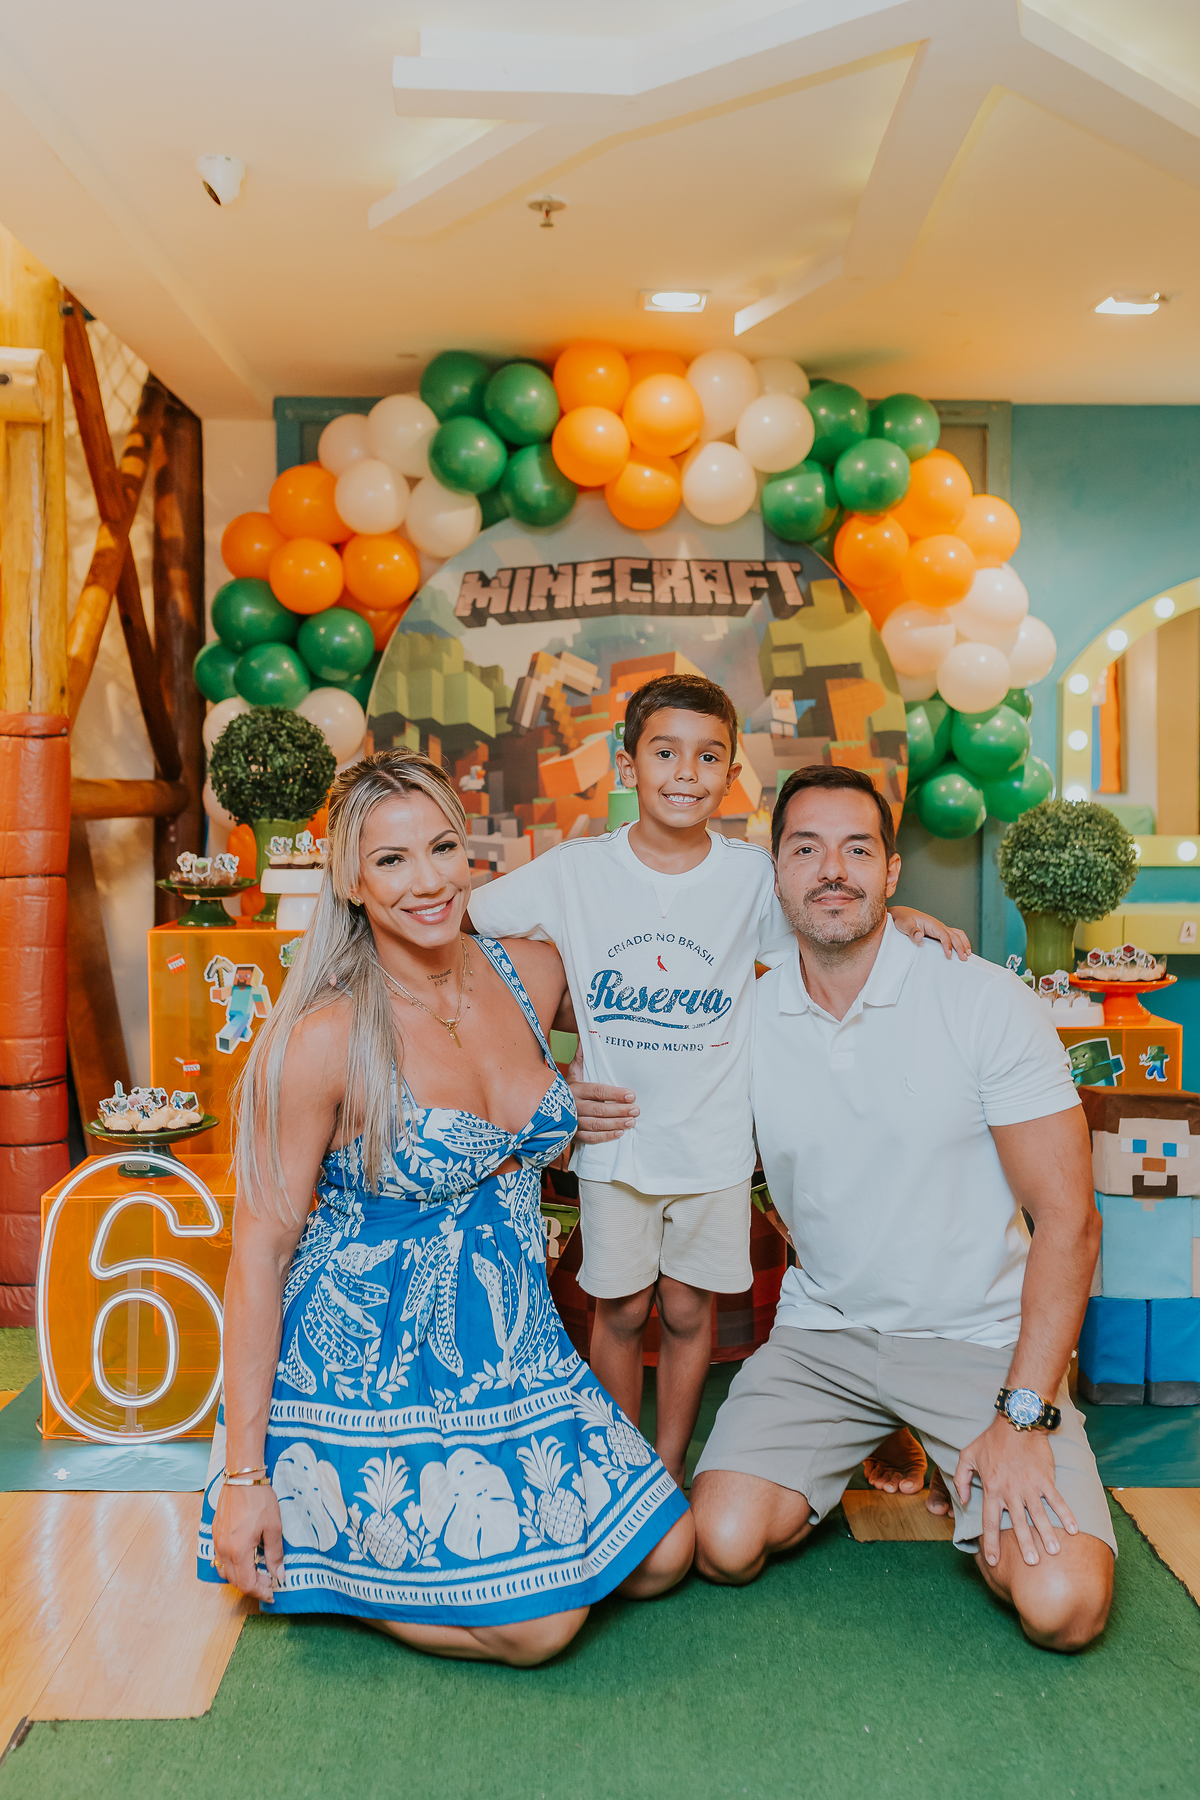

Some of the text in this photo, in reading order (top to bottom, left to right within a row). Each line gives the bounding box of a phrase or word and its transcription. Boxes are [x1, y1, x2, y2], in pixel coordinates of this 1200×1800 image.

[453, 556, 804, 628] MINECRAFT
[607, 932, 715, 967] CRIADO NO BRASIL
[586, 969, 732, 1015] Reserva
[605, 1035, 704, 1052] FEITO PRO MUNDO
[37, 1151, 224, 1444] 6
